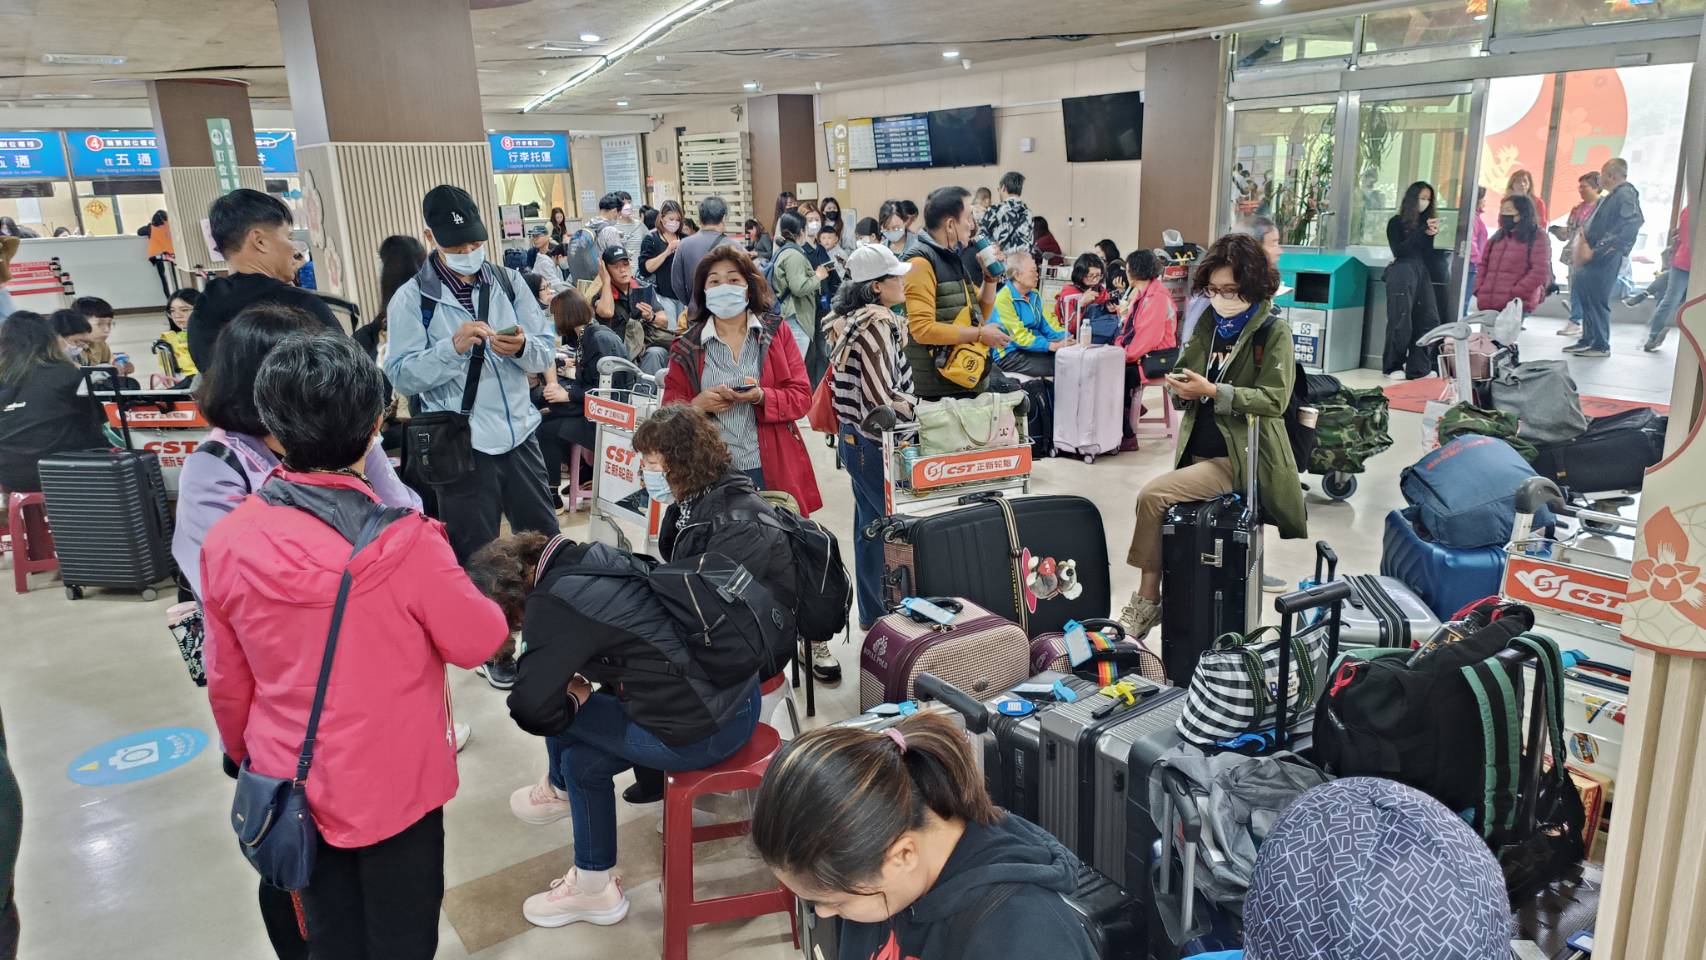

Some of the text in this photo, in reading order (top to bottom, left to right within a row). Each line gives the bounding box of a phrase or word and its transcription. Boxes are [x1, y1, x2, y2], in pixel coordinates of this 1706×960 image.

[90, 137, 99, 149] 4
[503, 138, 512, 147] 8
[508, 151, 551, 163] 行李托運
[451, 211, 464, 225] LA
[144, 441, 199, 455] CST
[606, 446, 635, 465] CST
[947, 464, 976, 475] CST
[1569, 589, 1625, 608] CST
